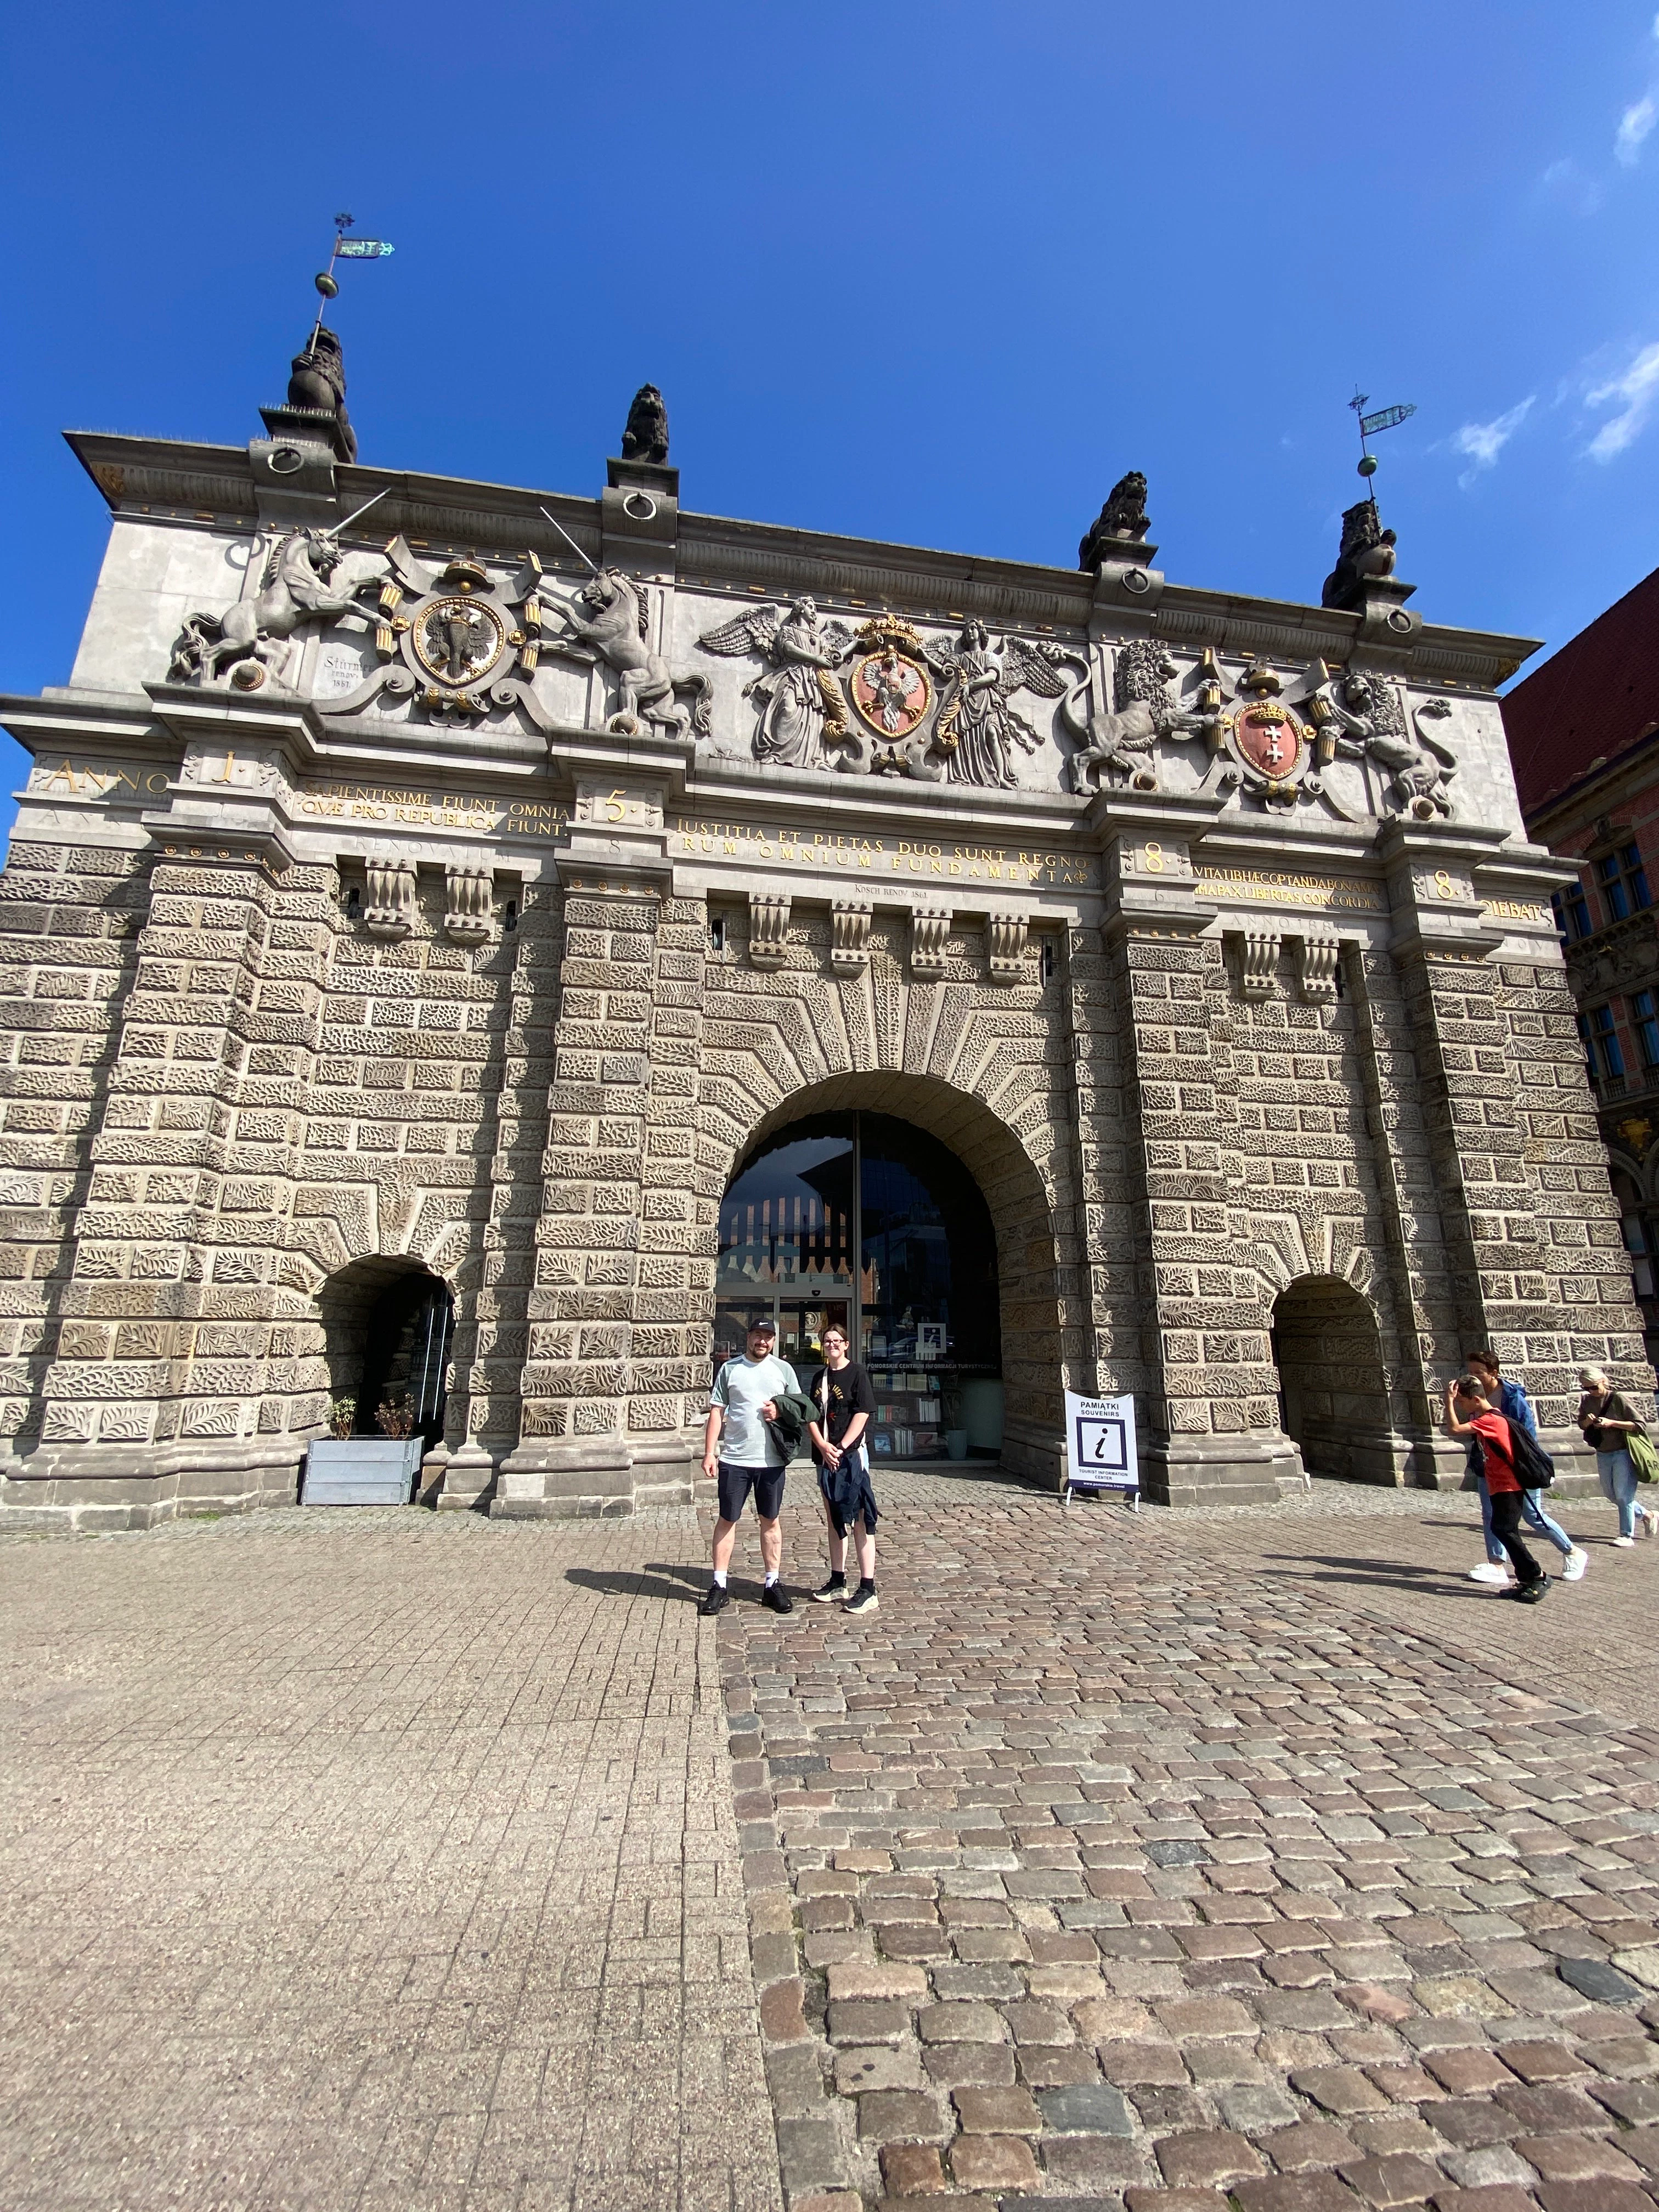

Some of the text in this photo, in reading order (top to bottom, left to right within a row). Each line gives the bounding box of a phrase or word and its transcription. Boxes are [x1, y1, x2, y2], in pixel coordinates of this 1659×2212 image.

[41, 759, 171, 794] ANNO
[304, 781, 570, 821] SAPIENTISSIME FIUNT OMNIA
[351, 805, 388, 820] PRO
[394, 809, 496, 830] REPUBLICA
[676, 819, 766, 842] IUSTITIA
[778, 831, 802, 845] ET
[813, 834, 883, 853] PIETAS
[899, 842, 941, 858] DUO
[953, 847, 1006, 863] SUNT
[682, 838, 1073, 884] RUM OMNIUM FUNDAMENTA
[1244, 887, 1300, 904] LIBERTAS
[1302, 892, 1381, 910] CONCORDIA
[1081, 1401, 1119, 1410] PAMIĄTKI
